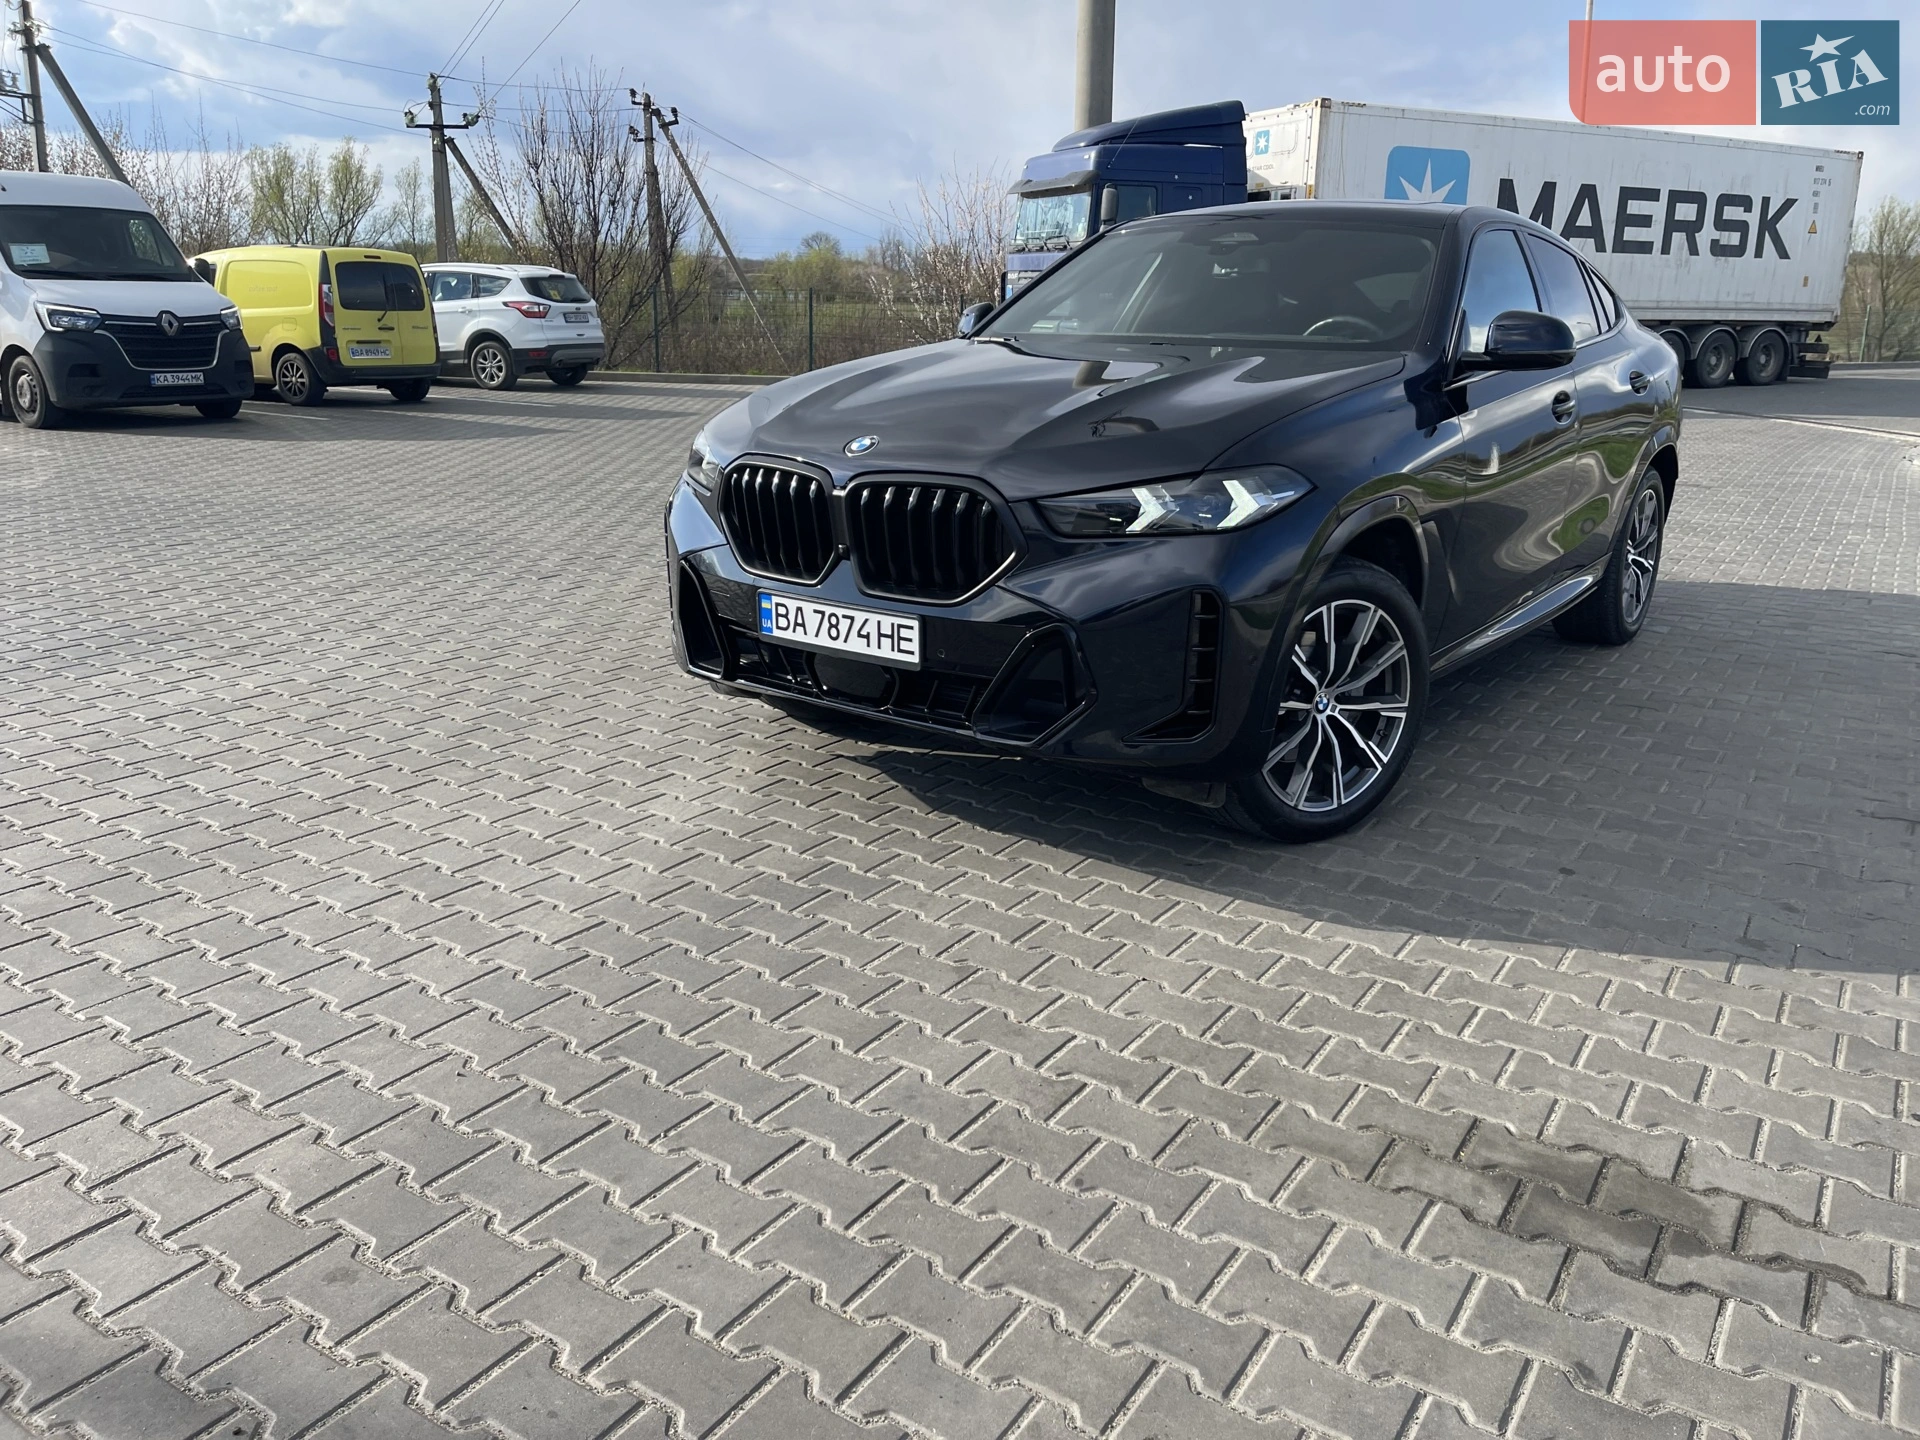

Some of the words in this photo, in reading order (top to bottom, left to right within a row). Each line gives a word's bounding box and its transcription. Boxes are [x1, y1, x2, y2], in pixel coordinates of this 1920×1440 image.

[1496, 177, 1799, 261] MAERSK
[762, 618, 772, 628] UA
[774, 602, 808, 636] BA
[812, 609, 871, 648] 7874
[876, 620, 915, 656] HE
